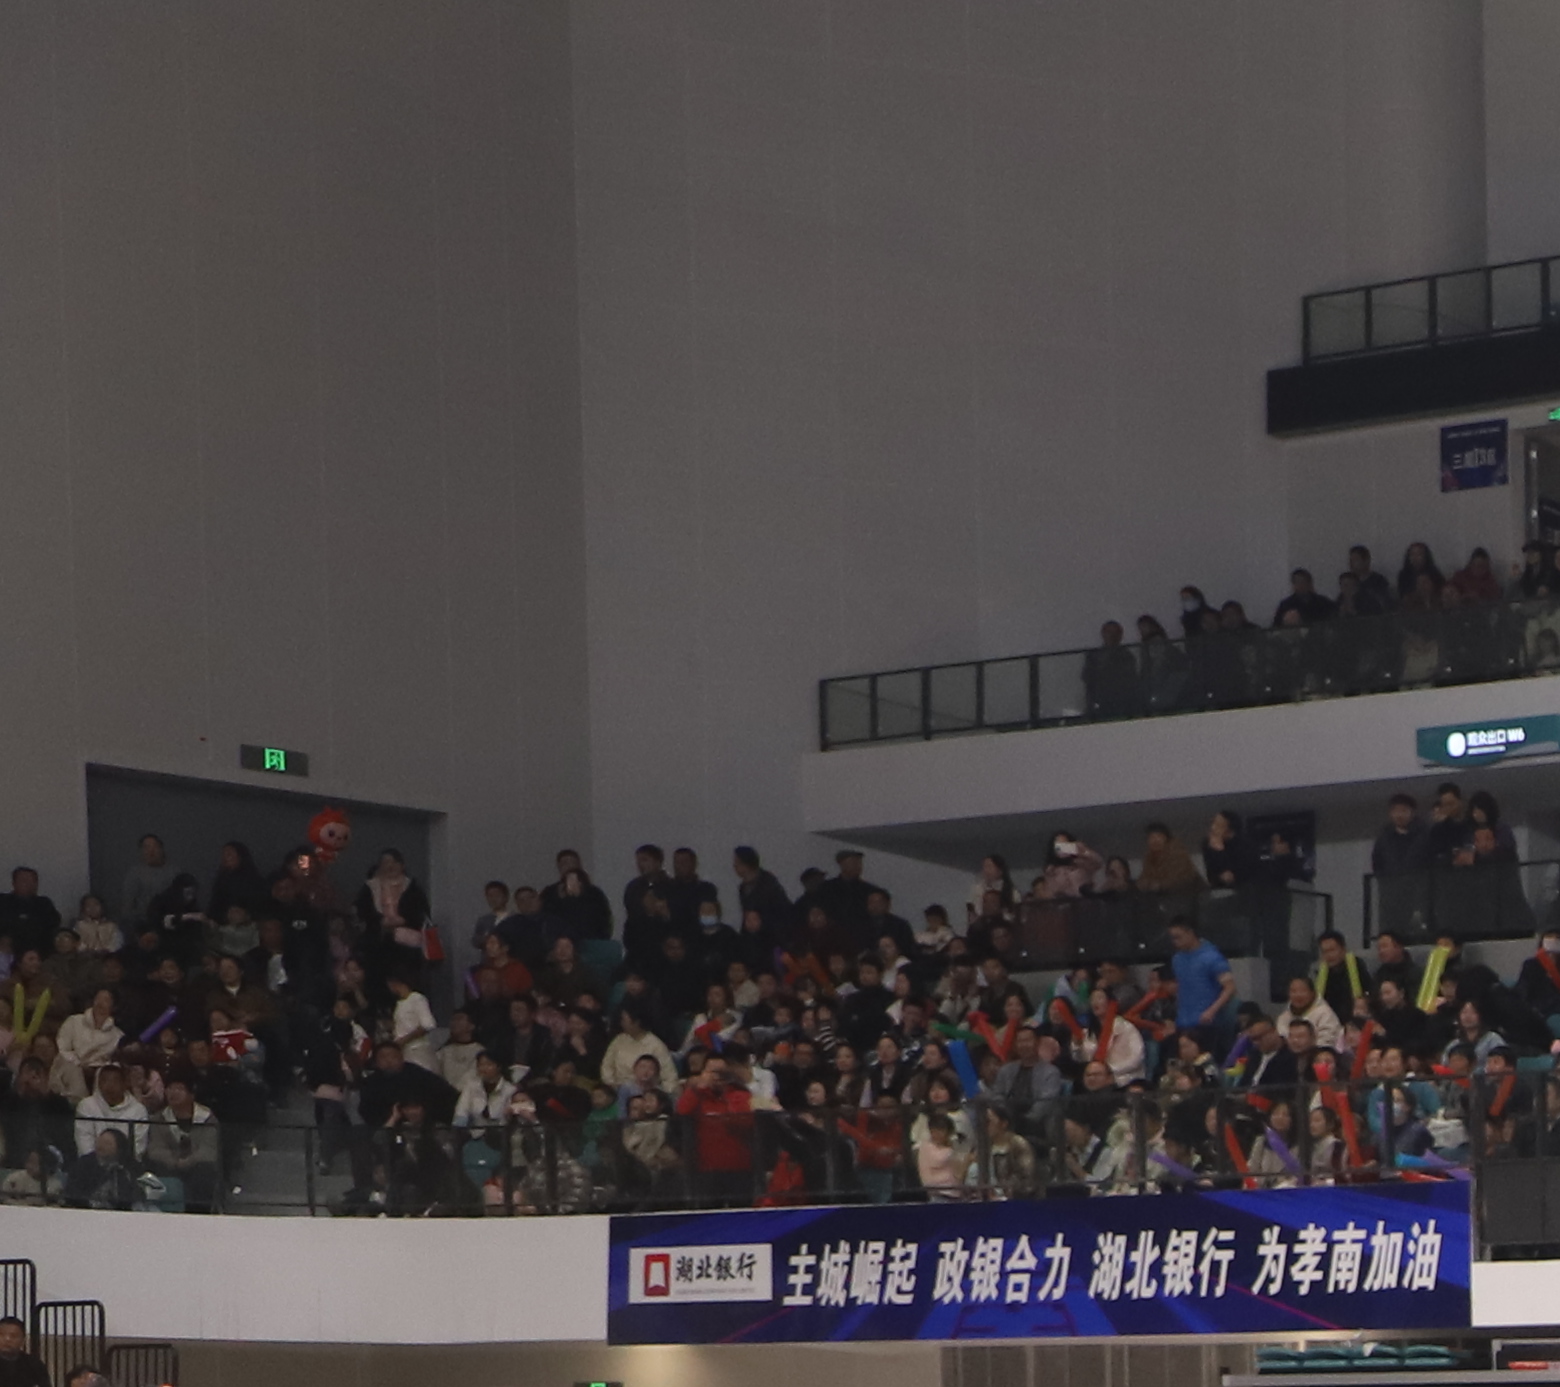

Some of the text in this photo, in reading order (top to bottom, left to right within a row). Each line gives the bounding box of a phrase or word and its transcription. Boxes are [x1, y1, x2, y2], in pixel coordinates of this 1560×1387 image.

[675, 1252, 758, 1282] 湖北银行
[783, 1218, 1442, 1307] 主城崛起 政银合力 湖北银行 为孝南加油
